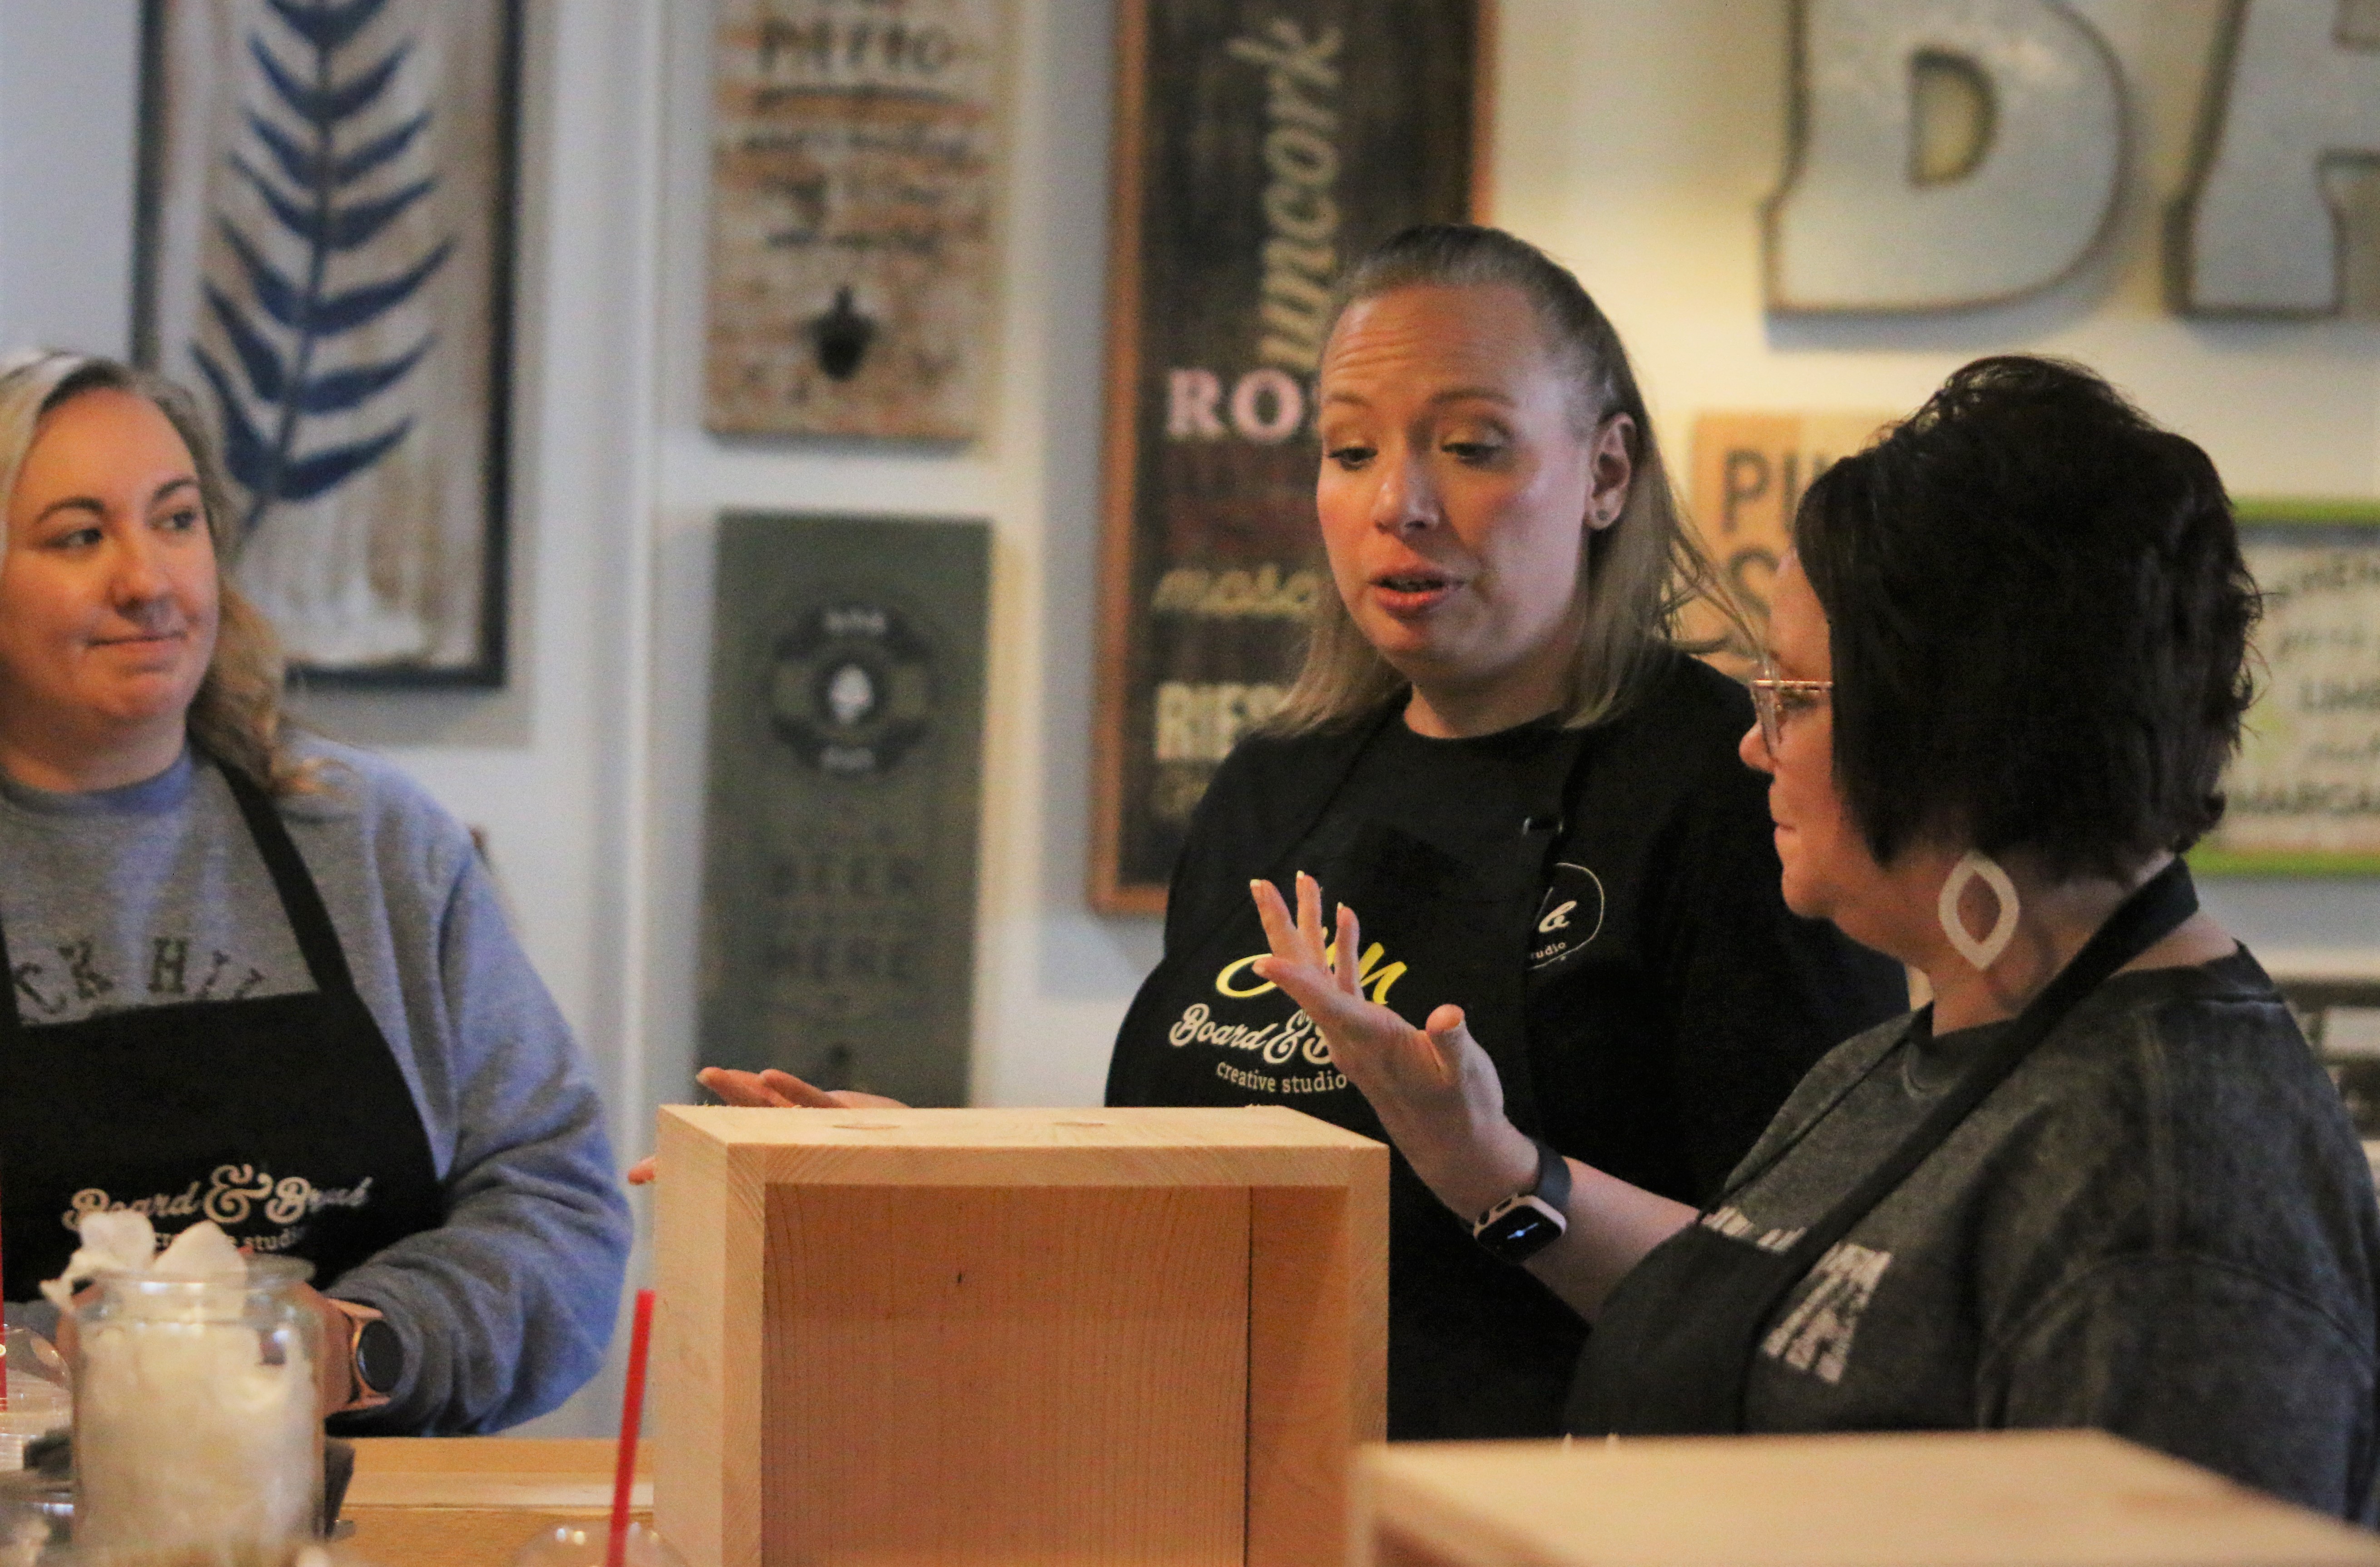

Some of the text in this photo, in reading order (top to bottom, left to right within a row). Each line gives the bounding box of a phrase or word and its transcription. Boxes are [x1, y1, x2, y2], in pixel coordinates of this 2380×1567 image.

[1227, 18, 1342, 373] uncork
[1165, 367, 1319, 445] RO
[1169, 1003, 1278, 1051] Board
[1216, 1061, 1347, 1093] creative studio
[203, 1164, 273, 1224] &
